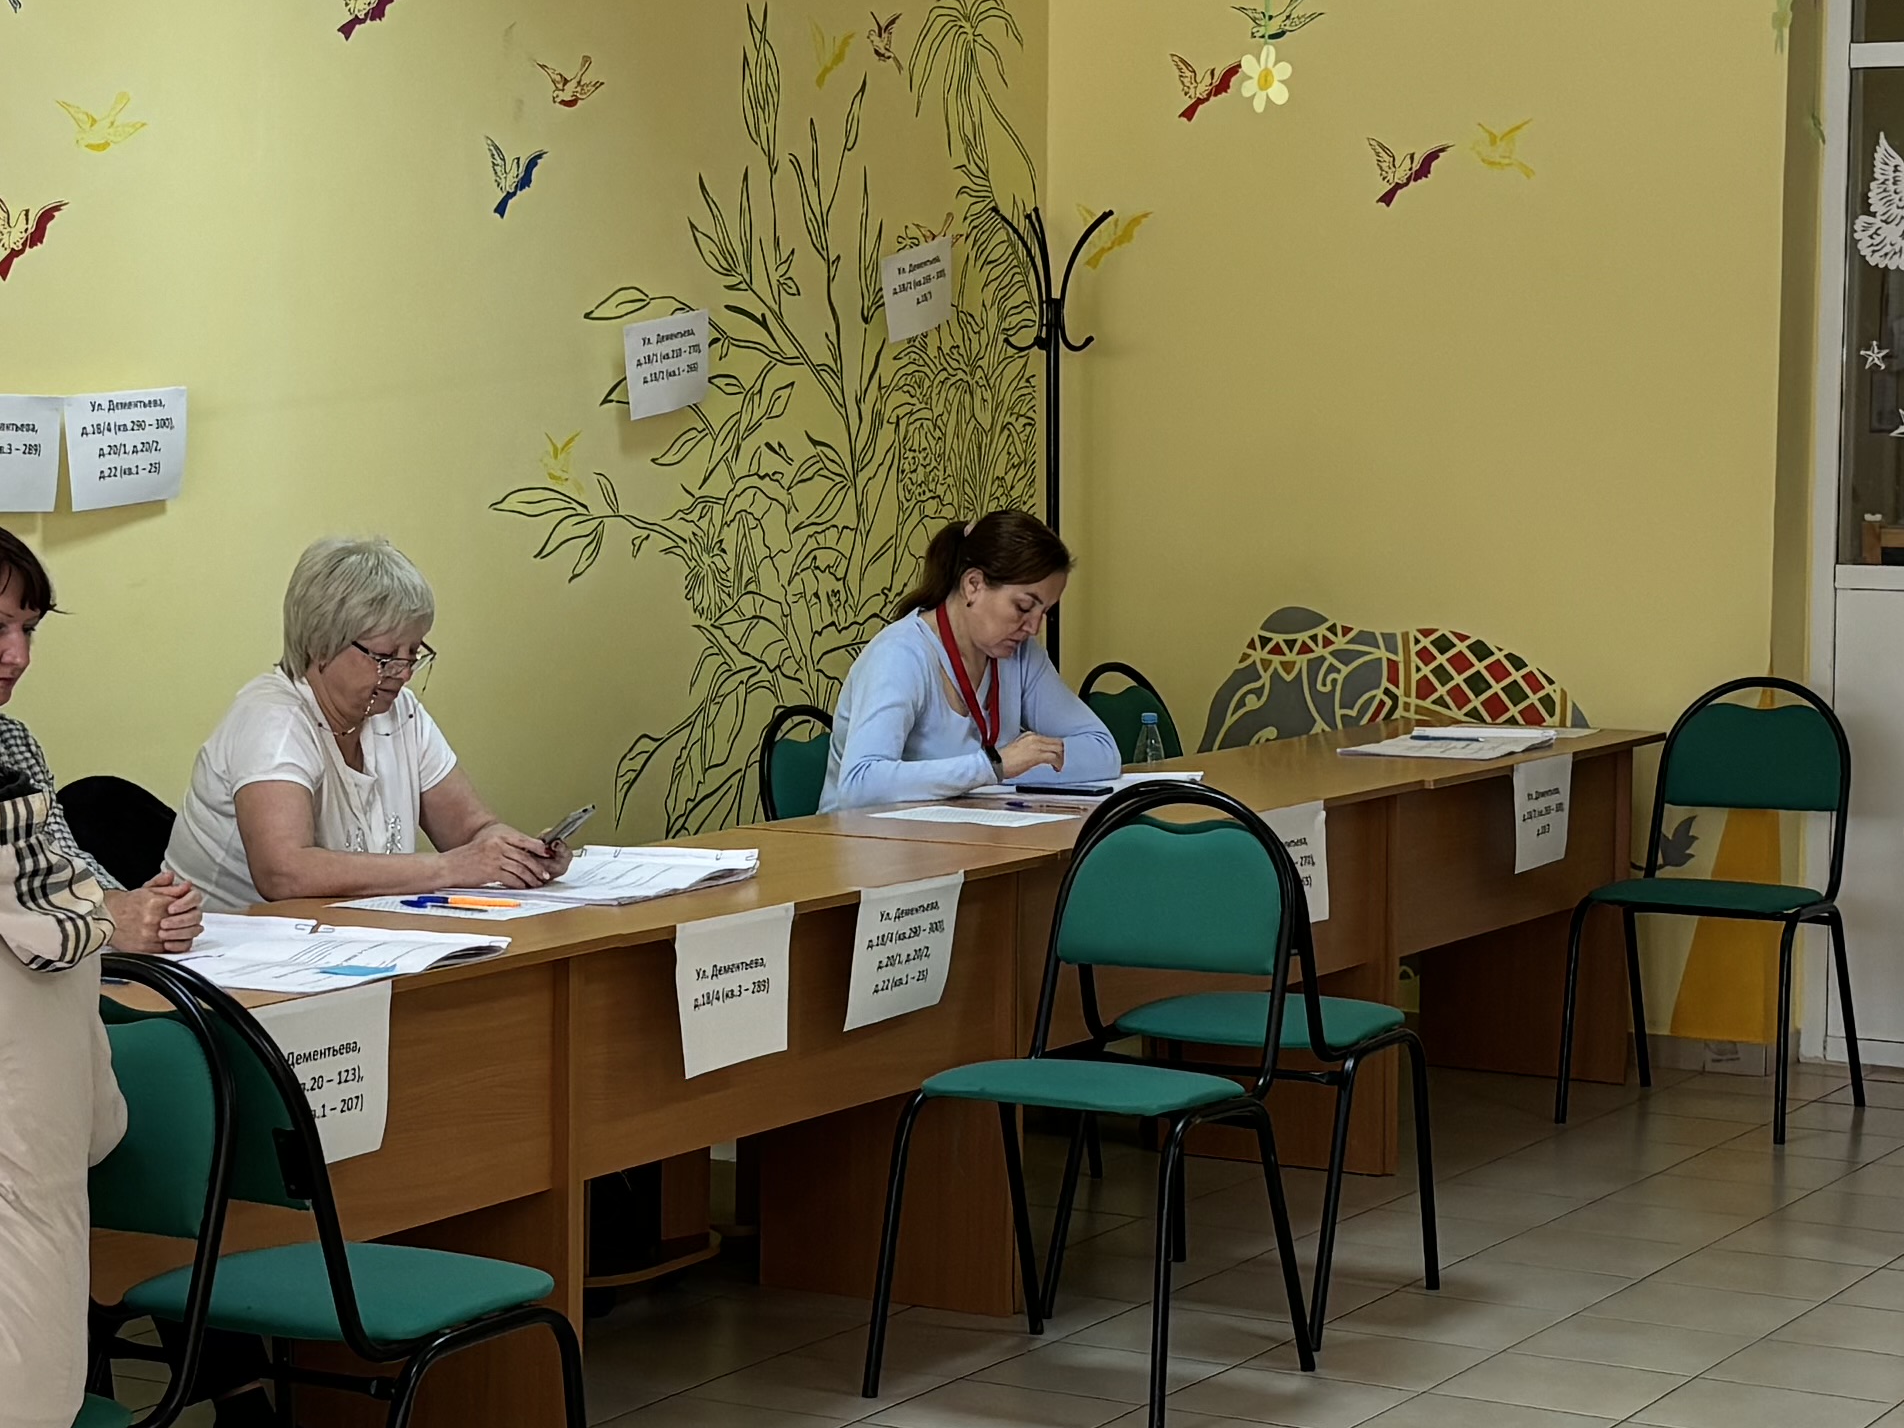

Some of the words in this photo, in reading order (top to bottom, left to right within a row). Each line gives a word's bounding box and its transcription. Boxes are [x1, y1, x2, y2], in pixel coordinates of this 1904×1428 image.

[90, 401, 105, 412] Ул.
[337, 1065, 364, 1085] 123),
[340, 1093, 363, 1113] 207)
